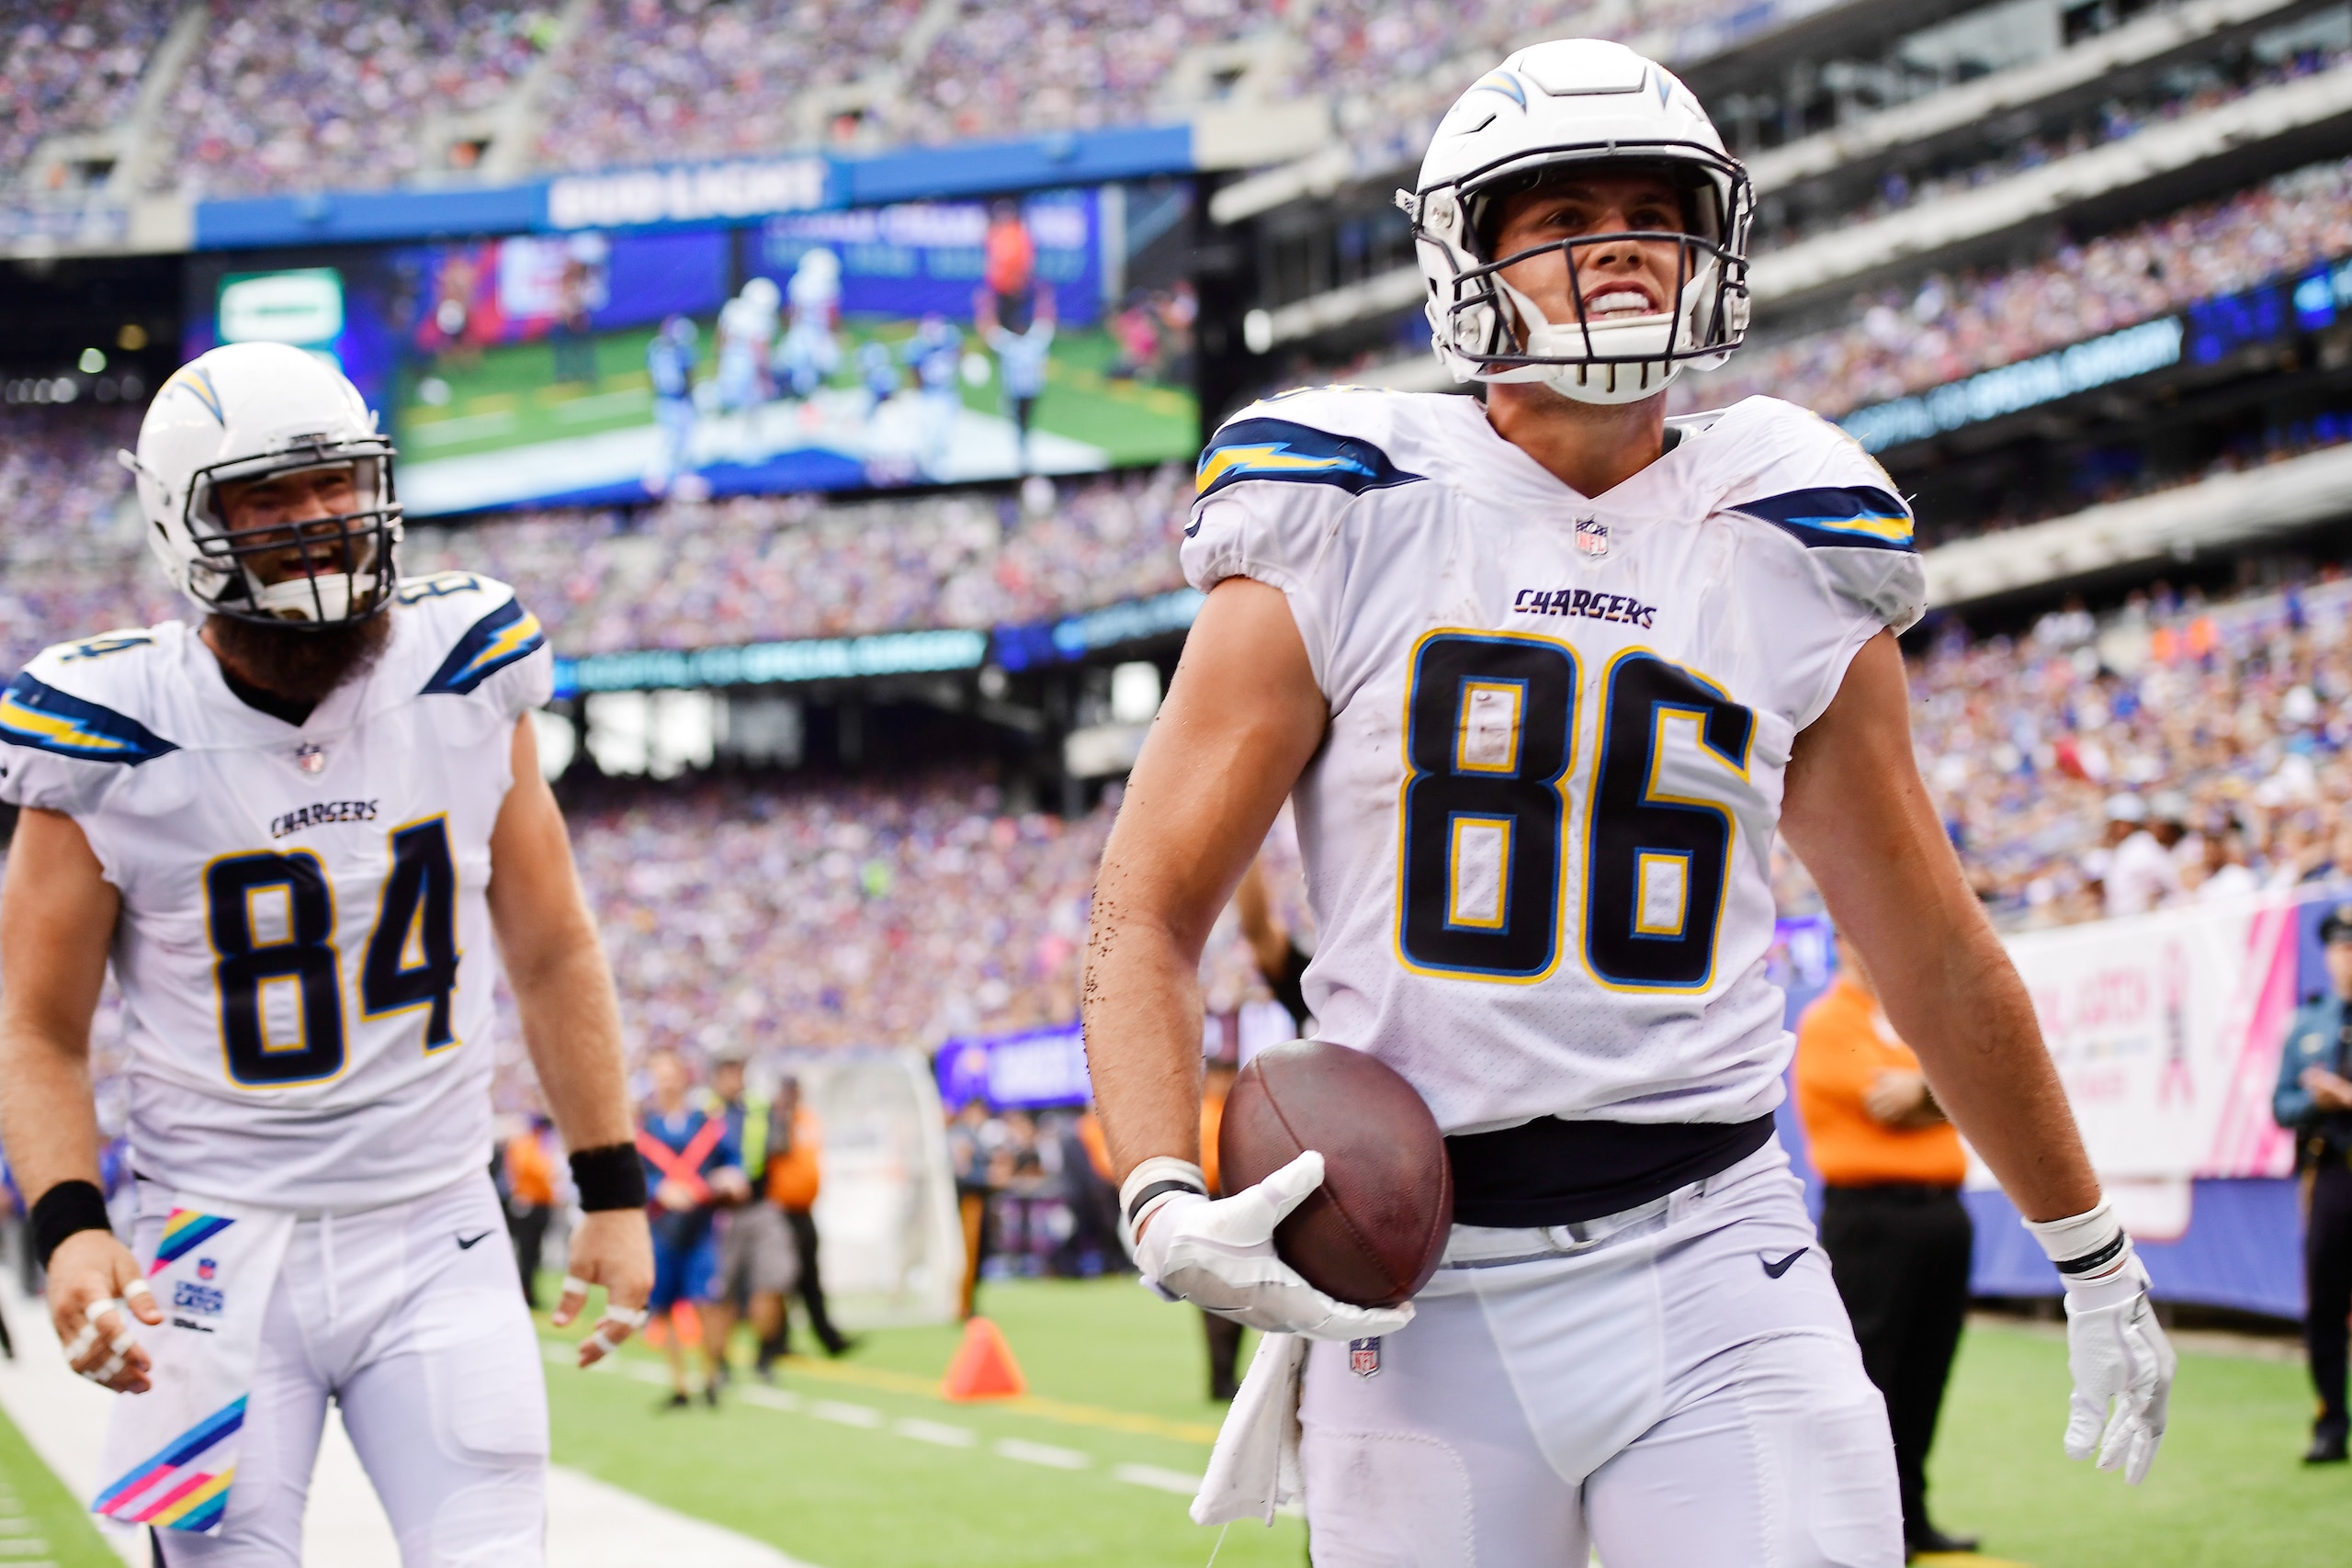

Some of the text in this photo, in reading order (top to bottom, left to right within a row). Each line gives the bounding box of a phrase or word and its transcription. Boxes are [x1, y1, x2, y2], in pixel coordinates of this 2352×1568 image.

[1514, 589, 1657, 629] CHARGERS
[271, 799, 378, 839] CHARGERS
[1394, 626, 1758, 994] 86
[201, 811, 463, 1090] 84
